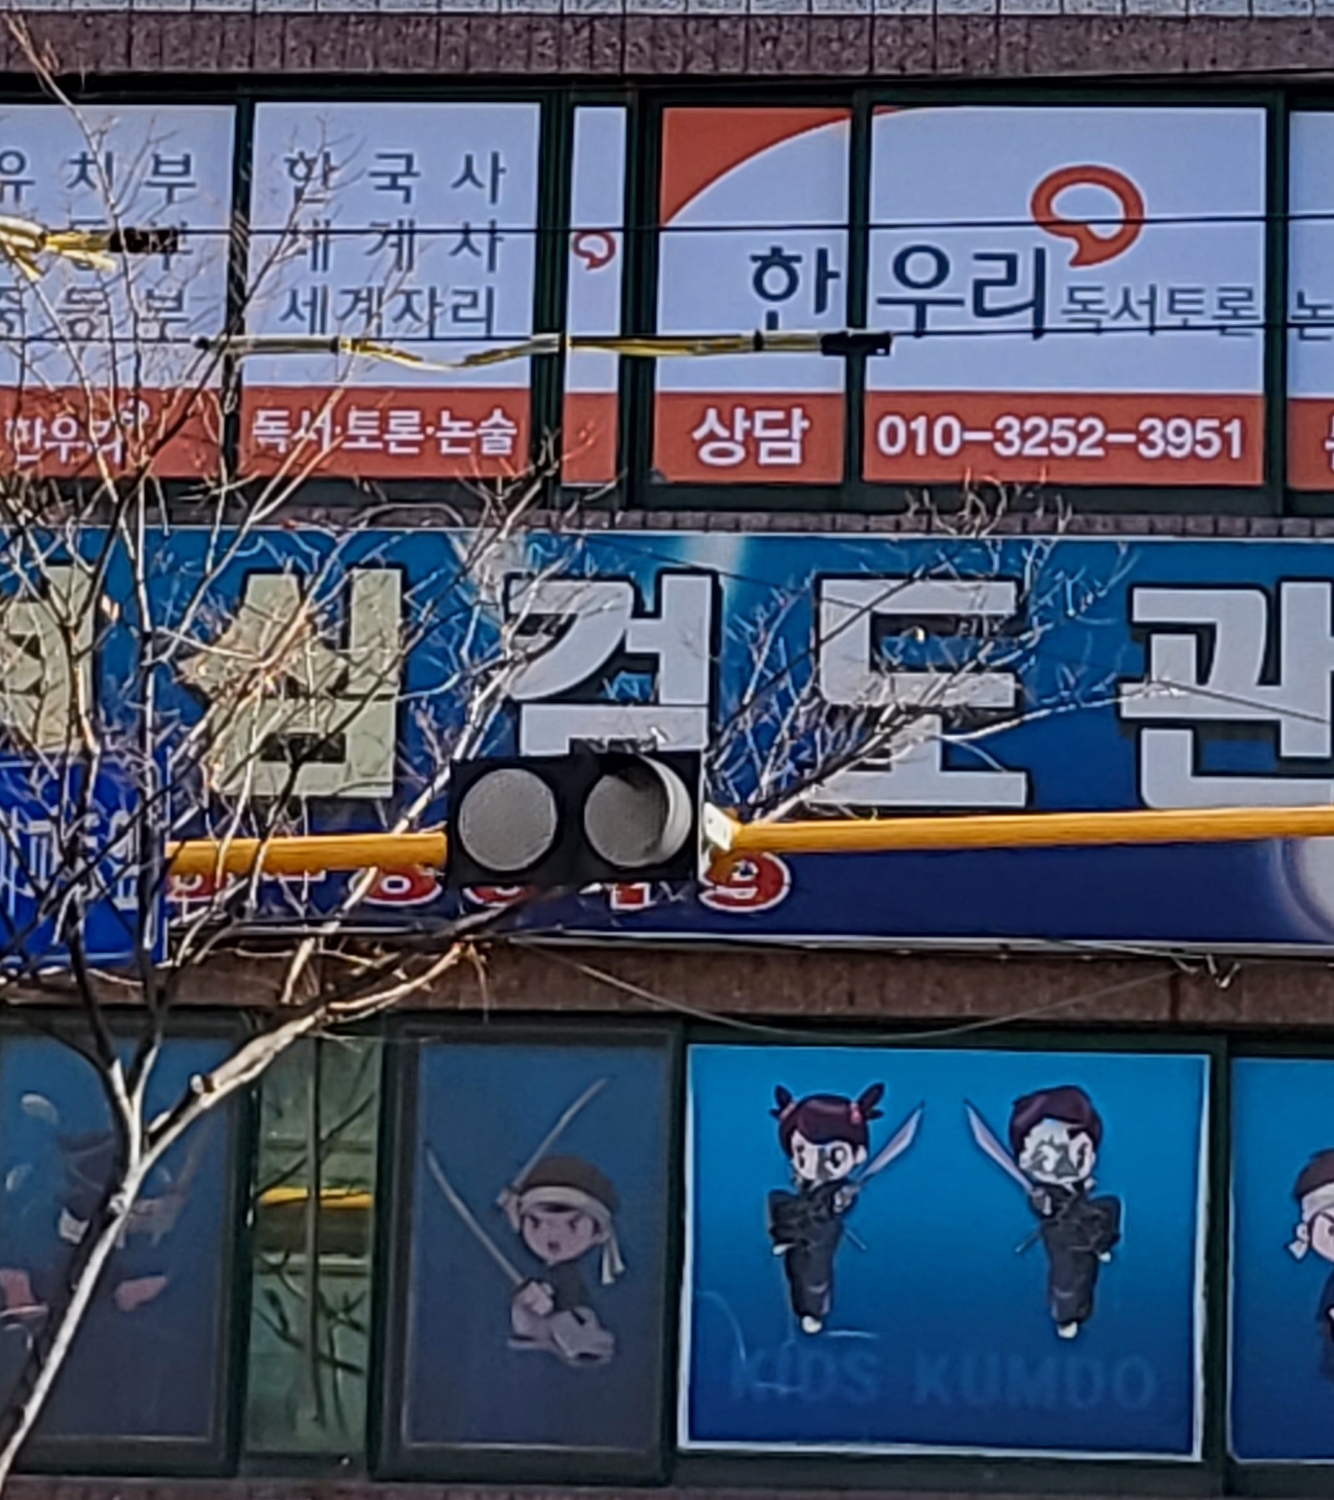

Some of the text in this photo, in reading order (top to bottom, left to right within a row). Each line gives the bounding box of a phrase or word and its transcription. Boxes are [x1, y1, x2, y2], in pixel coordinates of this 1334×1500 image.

[283, 150, 508, 206] 한국사
[692, 407, 810, 466] 상담
[877, 414, 1243, 460] 010-3252-3951
[913, 1349, 1157, 1410] KUMDO
